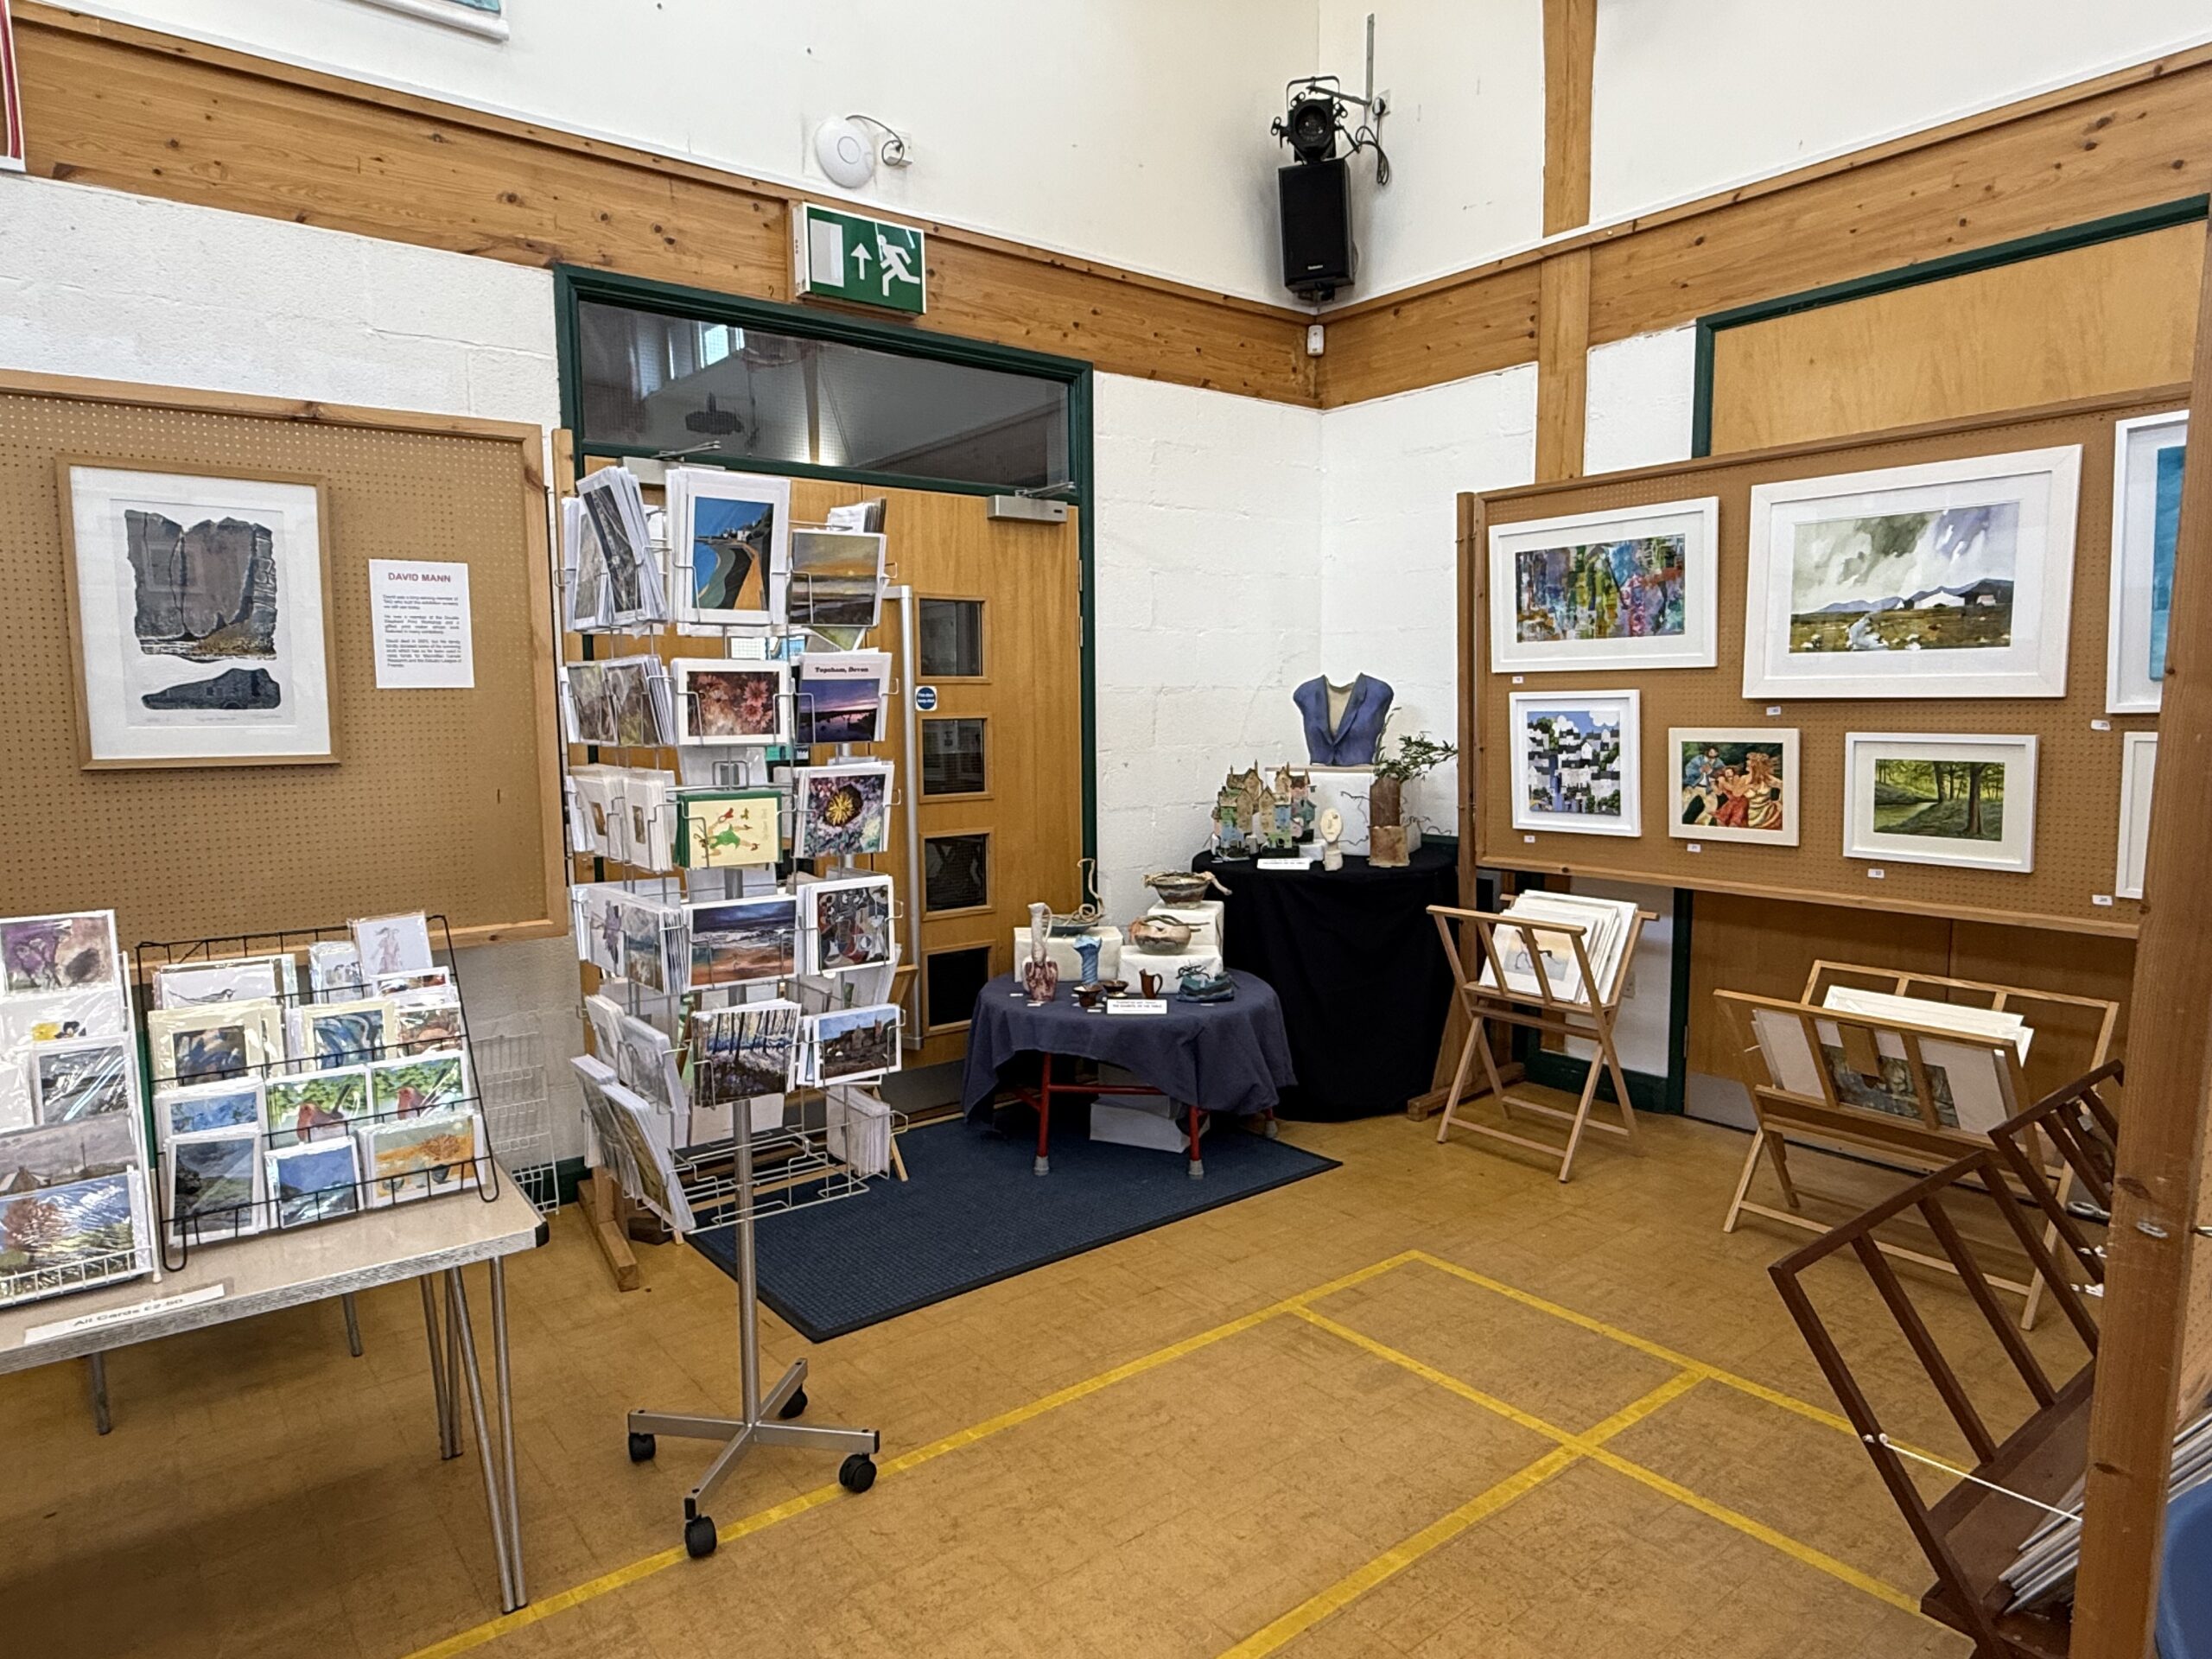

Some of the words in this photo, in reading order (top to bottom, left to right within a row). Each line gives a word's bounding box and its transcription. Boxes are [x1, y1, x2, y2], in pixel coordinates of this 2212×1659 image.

[388, 572, 418, 582] DAVID
[73, 1318, 92, 1326] All
[97, 1309, 139, 1321] Cards
